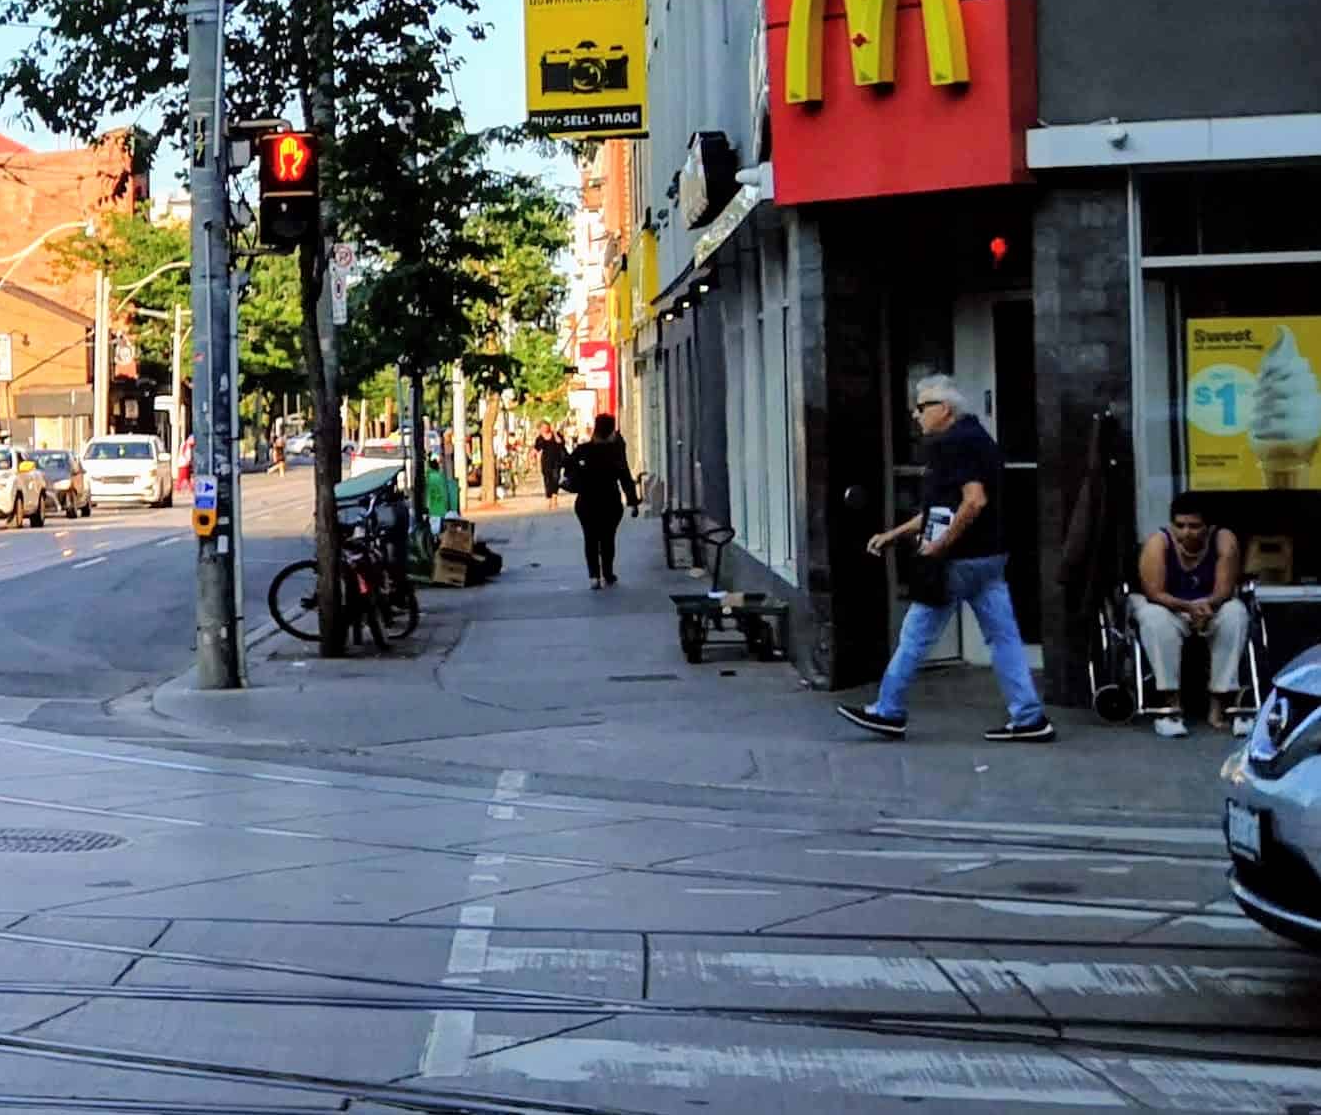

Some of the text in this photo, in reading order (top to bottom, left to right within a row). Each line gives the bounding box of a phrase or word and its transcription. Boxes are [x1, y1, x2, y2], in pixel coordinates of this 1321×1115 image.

[563, 114, 590, 127] SELL
[599, 111, 639, 125] TRADE
[1194, 328, 1253, 343] Sweet
[1194, 382, 1238, 426] $1
